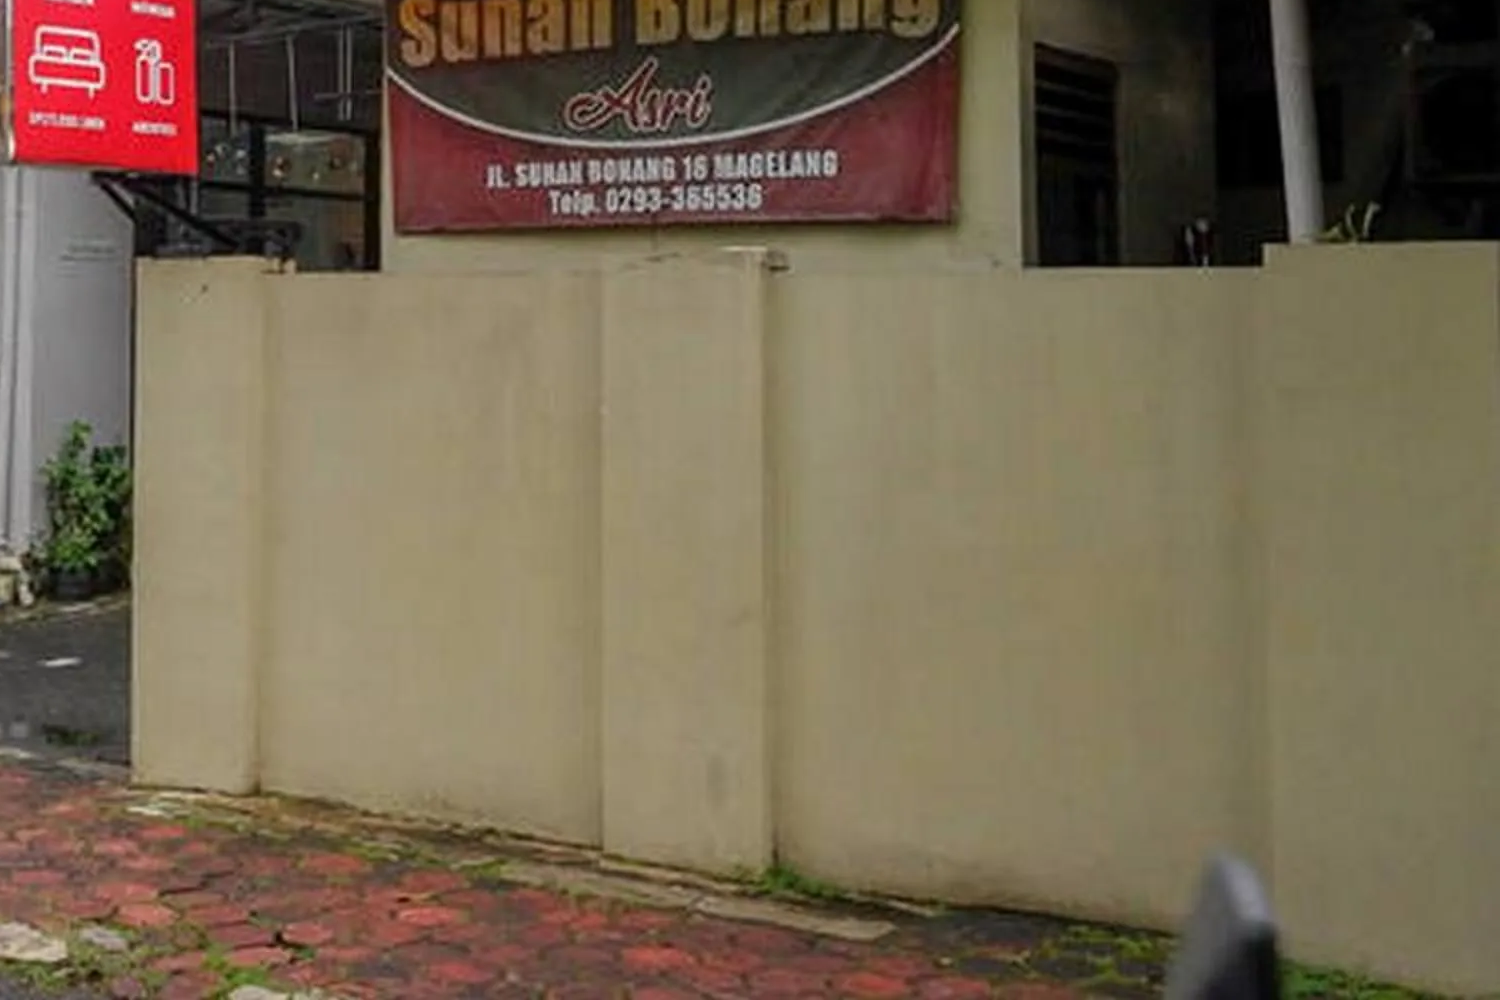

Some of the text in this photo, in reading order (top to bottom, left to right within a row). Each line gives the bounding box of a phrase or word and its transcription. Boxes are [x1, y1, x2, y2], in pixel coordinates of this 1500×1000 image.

[563, 55, 712, 133] Asri
[515, 159, 583, 187] SUNAN
[587, 155, 676, 184] BONANG
[713, 149, 839, 180] MAGELANG
